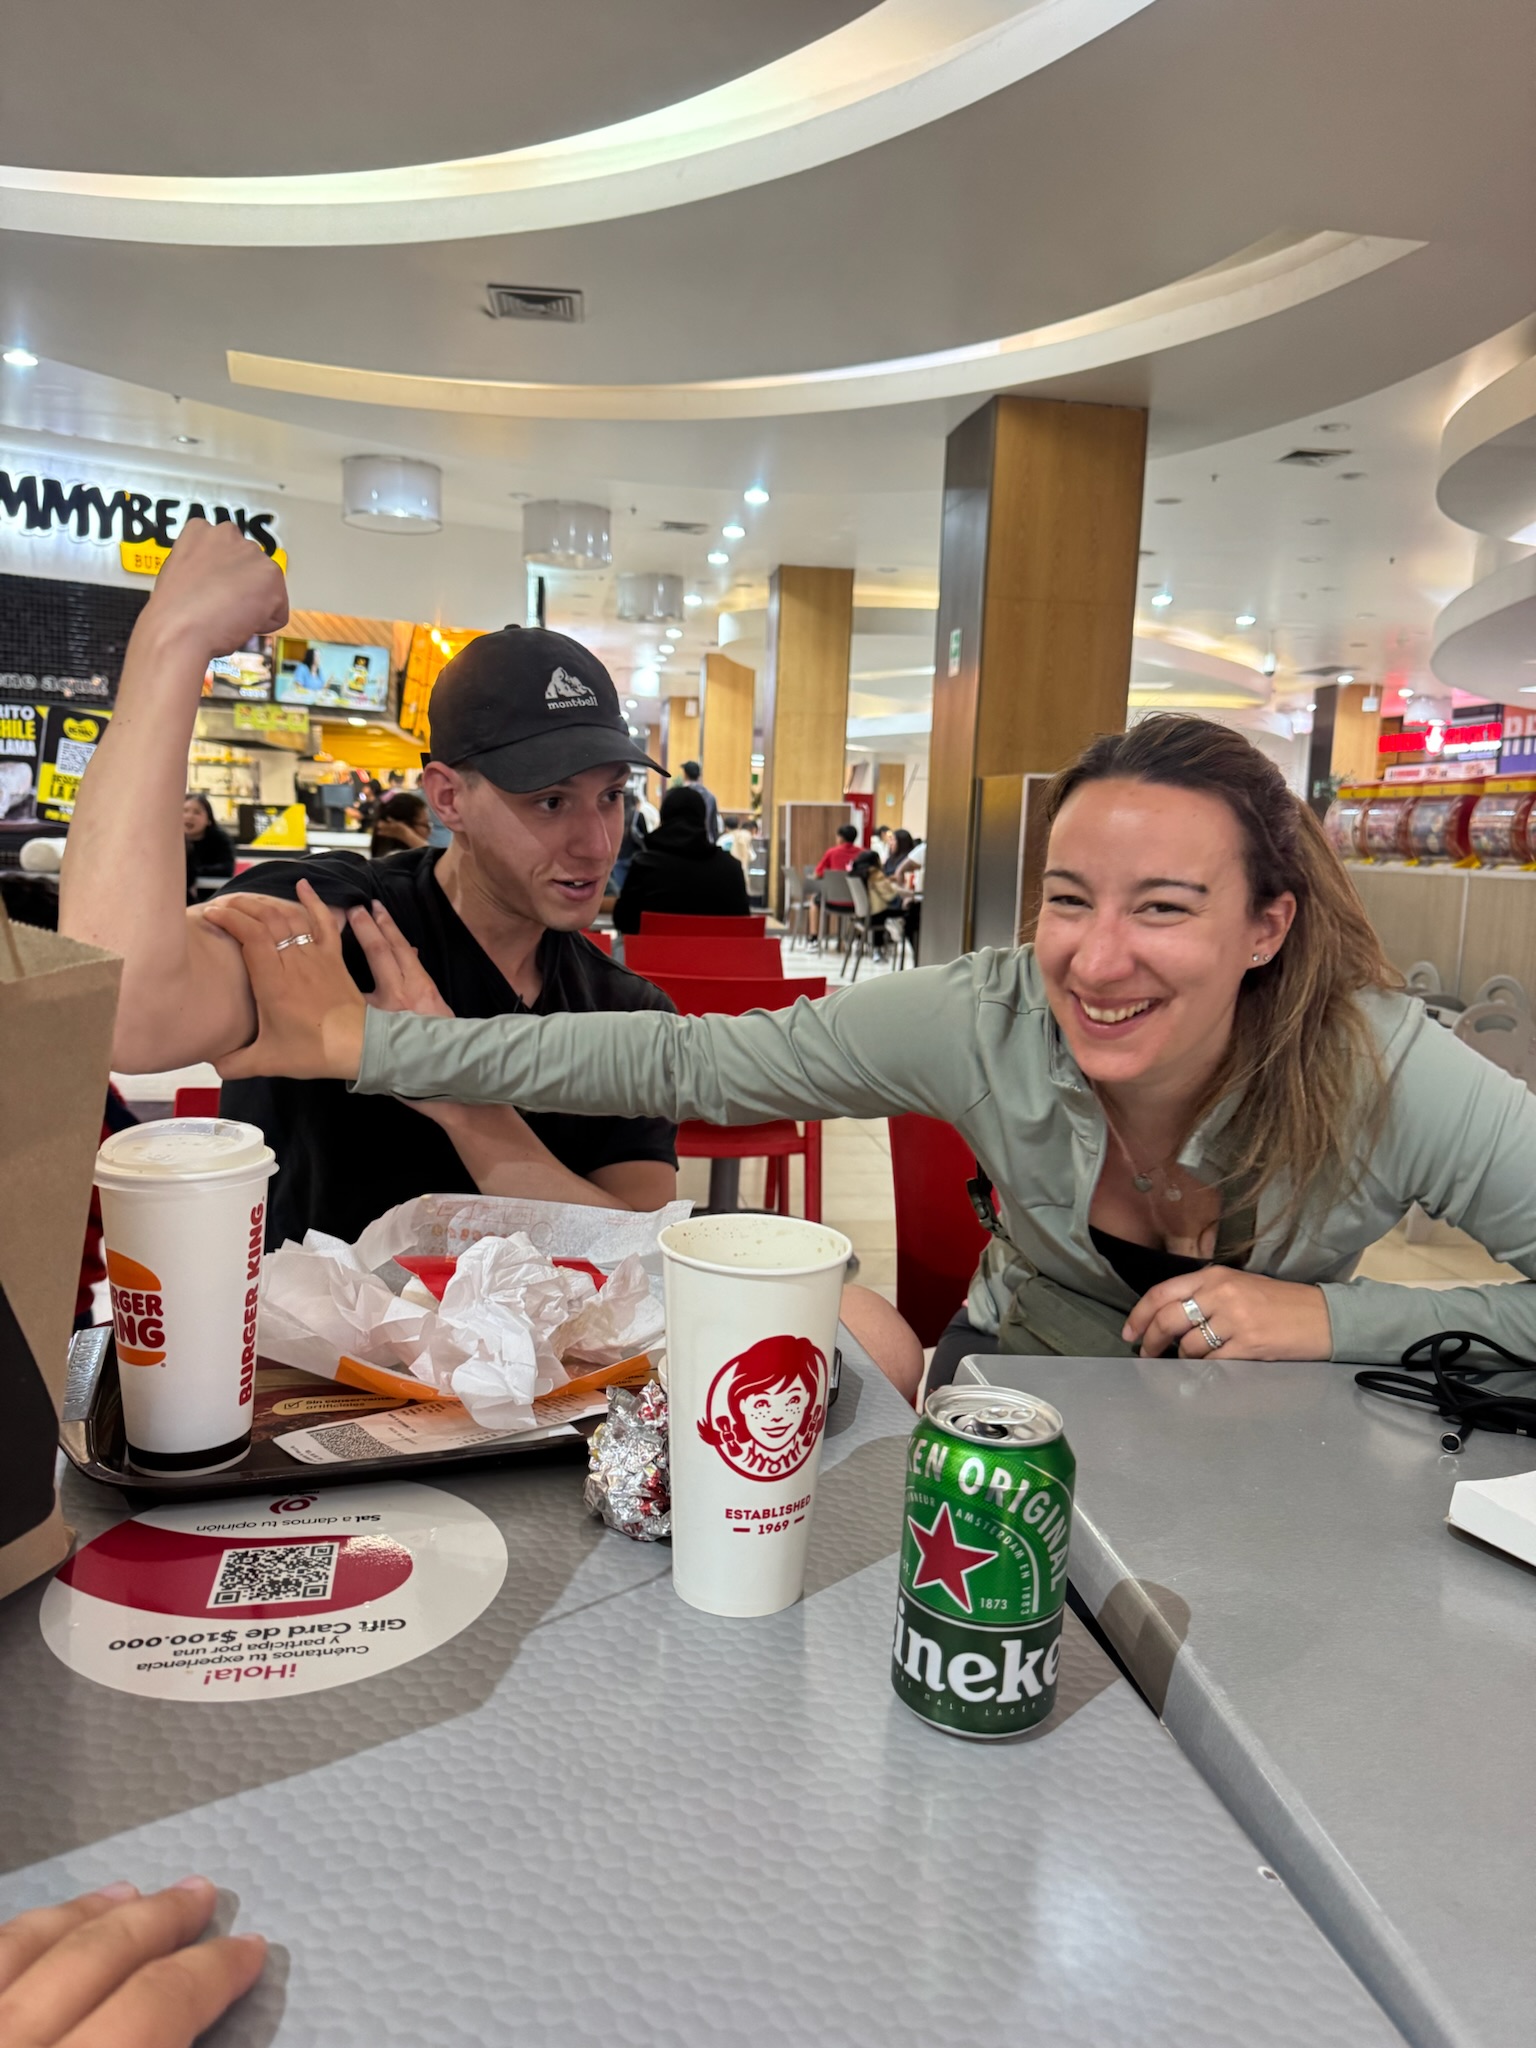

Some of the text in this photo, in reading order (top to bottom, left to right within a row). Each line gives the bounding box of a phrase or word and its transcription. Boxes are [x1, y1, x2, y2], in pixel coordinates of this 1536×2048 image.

[0, 719, 36, 740] HILE
[239, 1203, 263, 1406] BURGER KING
[725, 1494, 811, 1520] ESTABLISHED
[196, 1522, 256, 1532] opinión
[261, 1520, 277, 1528] tu
[282, 1517, 338, 1526] darnos
[356, 1514, 381, 1523] Sal
[758, 1519, 789, 1535] 1969
[958, 1456, 1069, 1592] ORIGINAL
[955, 1508, 1025, 1560] AMSTERDAM
[1019, 1563, 1031, 1580] EN
[980, 1597, 1008, 1610] 1873
[1020, 1586, 1031, 1615] 1883
[108, 1618, 407, 1650] Gift Card de $100.000
[173, 1635, 341, 1657] y participa por una
[136, 1645, 369, 1672] Cuéntanos tu experiencia
[203, 1663, 297, 1686] ¡Hola!
[924, 1693, 966, 1713] MALT
